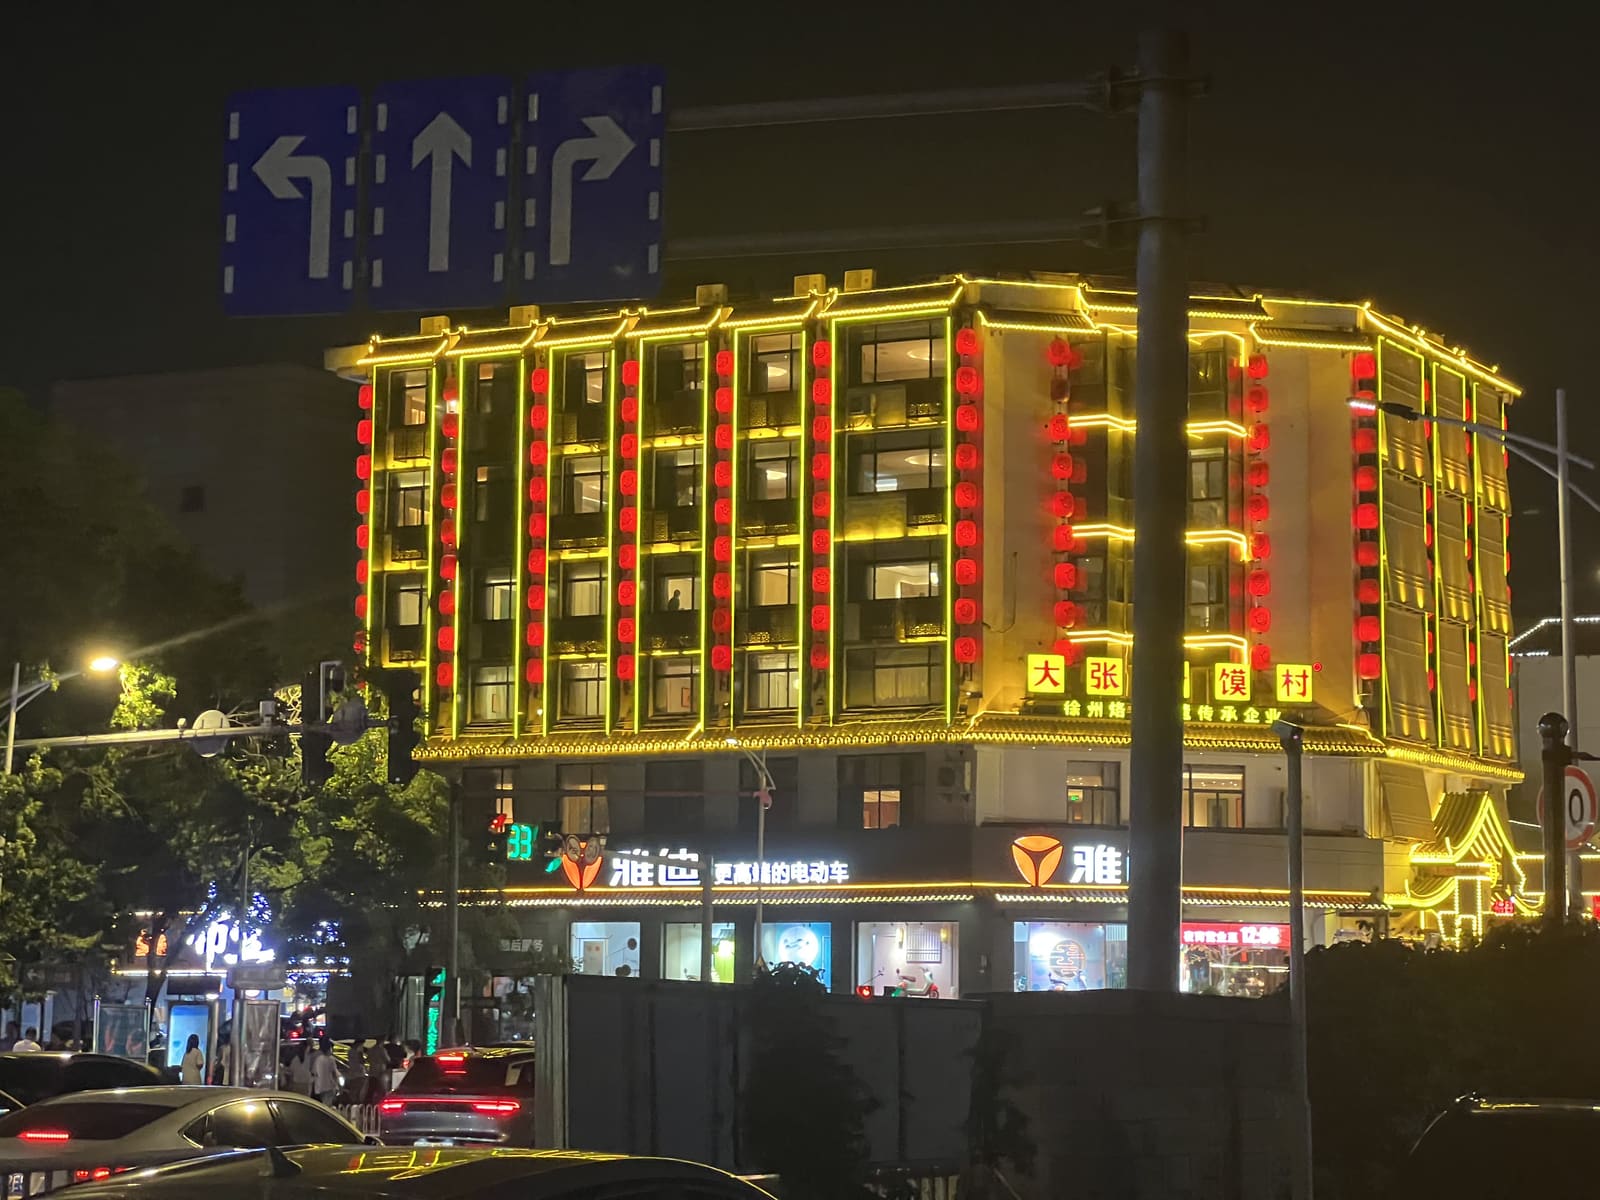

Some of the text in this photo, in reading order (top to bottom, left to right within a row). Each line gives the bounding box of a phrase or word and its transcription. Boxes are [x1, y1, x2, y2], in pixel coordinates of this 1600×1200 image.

[1033, 660, 1309, 697] 大张馍村
[609, 848, 850, 887] 雅迪 更高端的电动车
[1069, 844, 1130, 885] 雅
